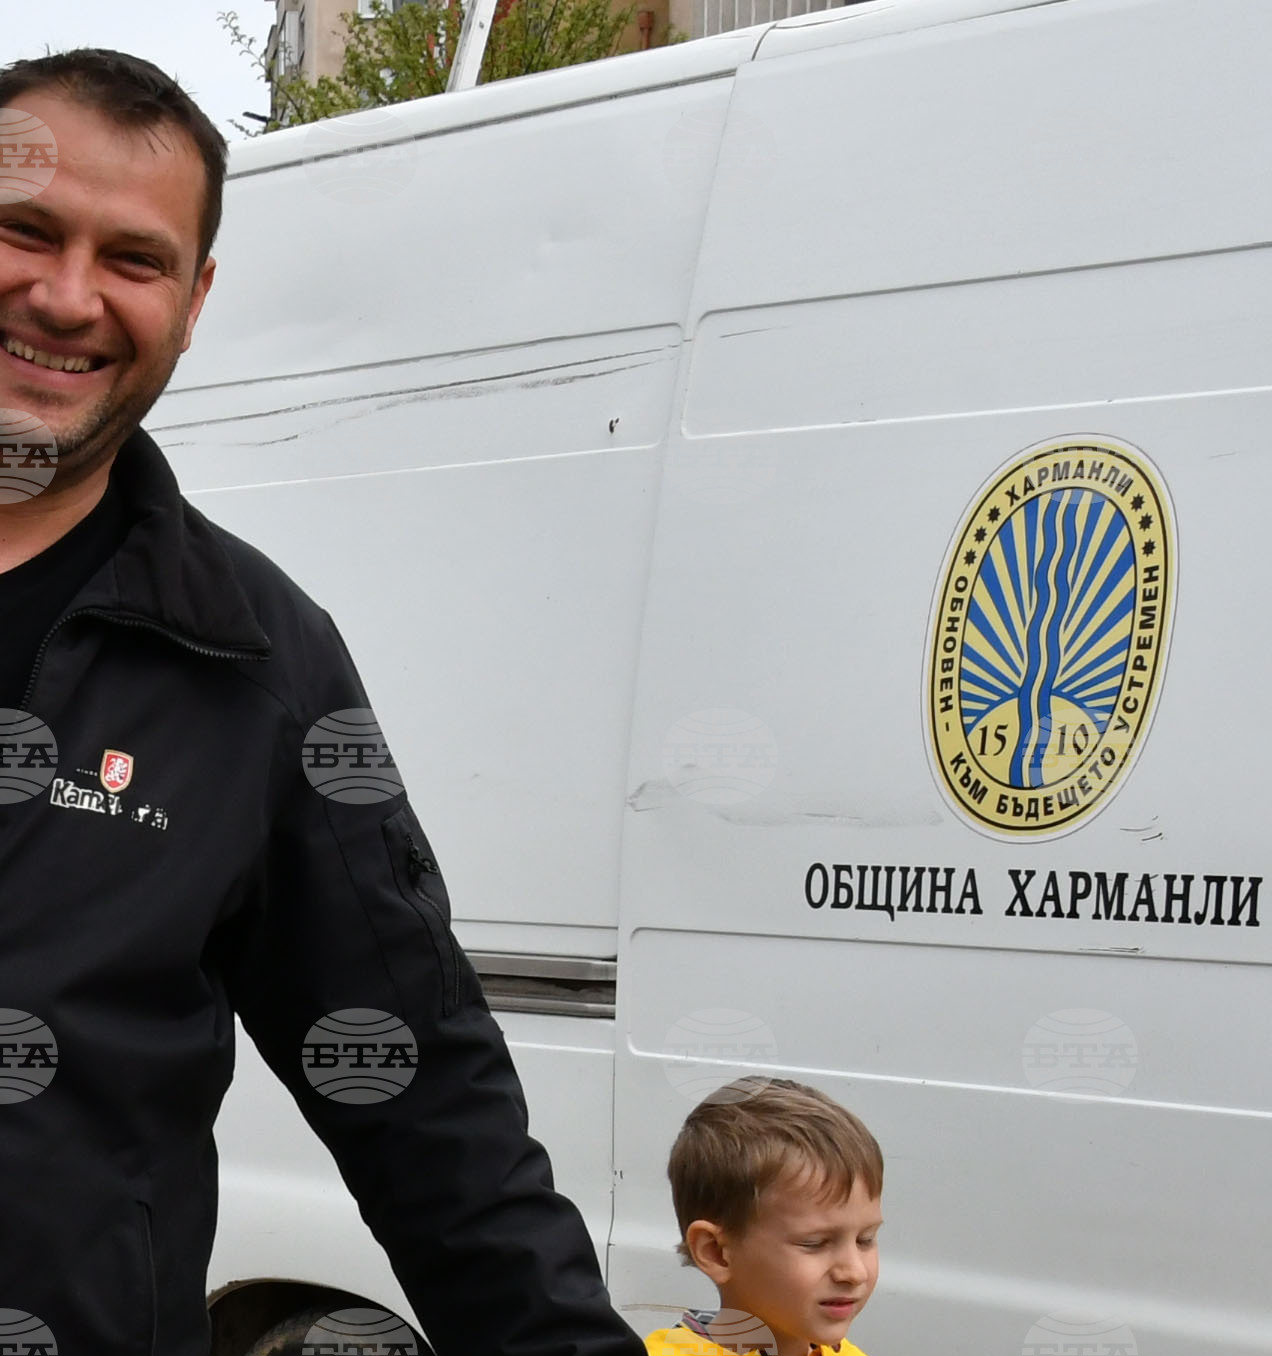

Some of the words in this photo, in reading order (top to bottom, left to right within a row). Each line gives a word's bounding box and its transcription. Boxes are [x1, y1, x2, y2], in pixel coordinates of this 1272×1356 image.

[1005, 459, 1134, 507] ХАРМАНЛИ
[939, 575, 969, 714] ОБНОВЕН
[1113, 565, 1160, 734] УСТРЕМЕН
[978, 723, 1009, 756] 15
[1057, 723, 1090, 755] 10
[949, 751, 989, 805] КЪМ
[995, 746, 1117, 822] БЪДЕЩЕТО
[805, 862, 983, 922] ОБЩИНА
[1005, 869, 1263, 927] ХАРМАНЛИ
